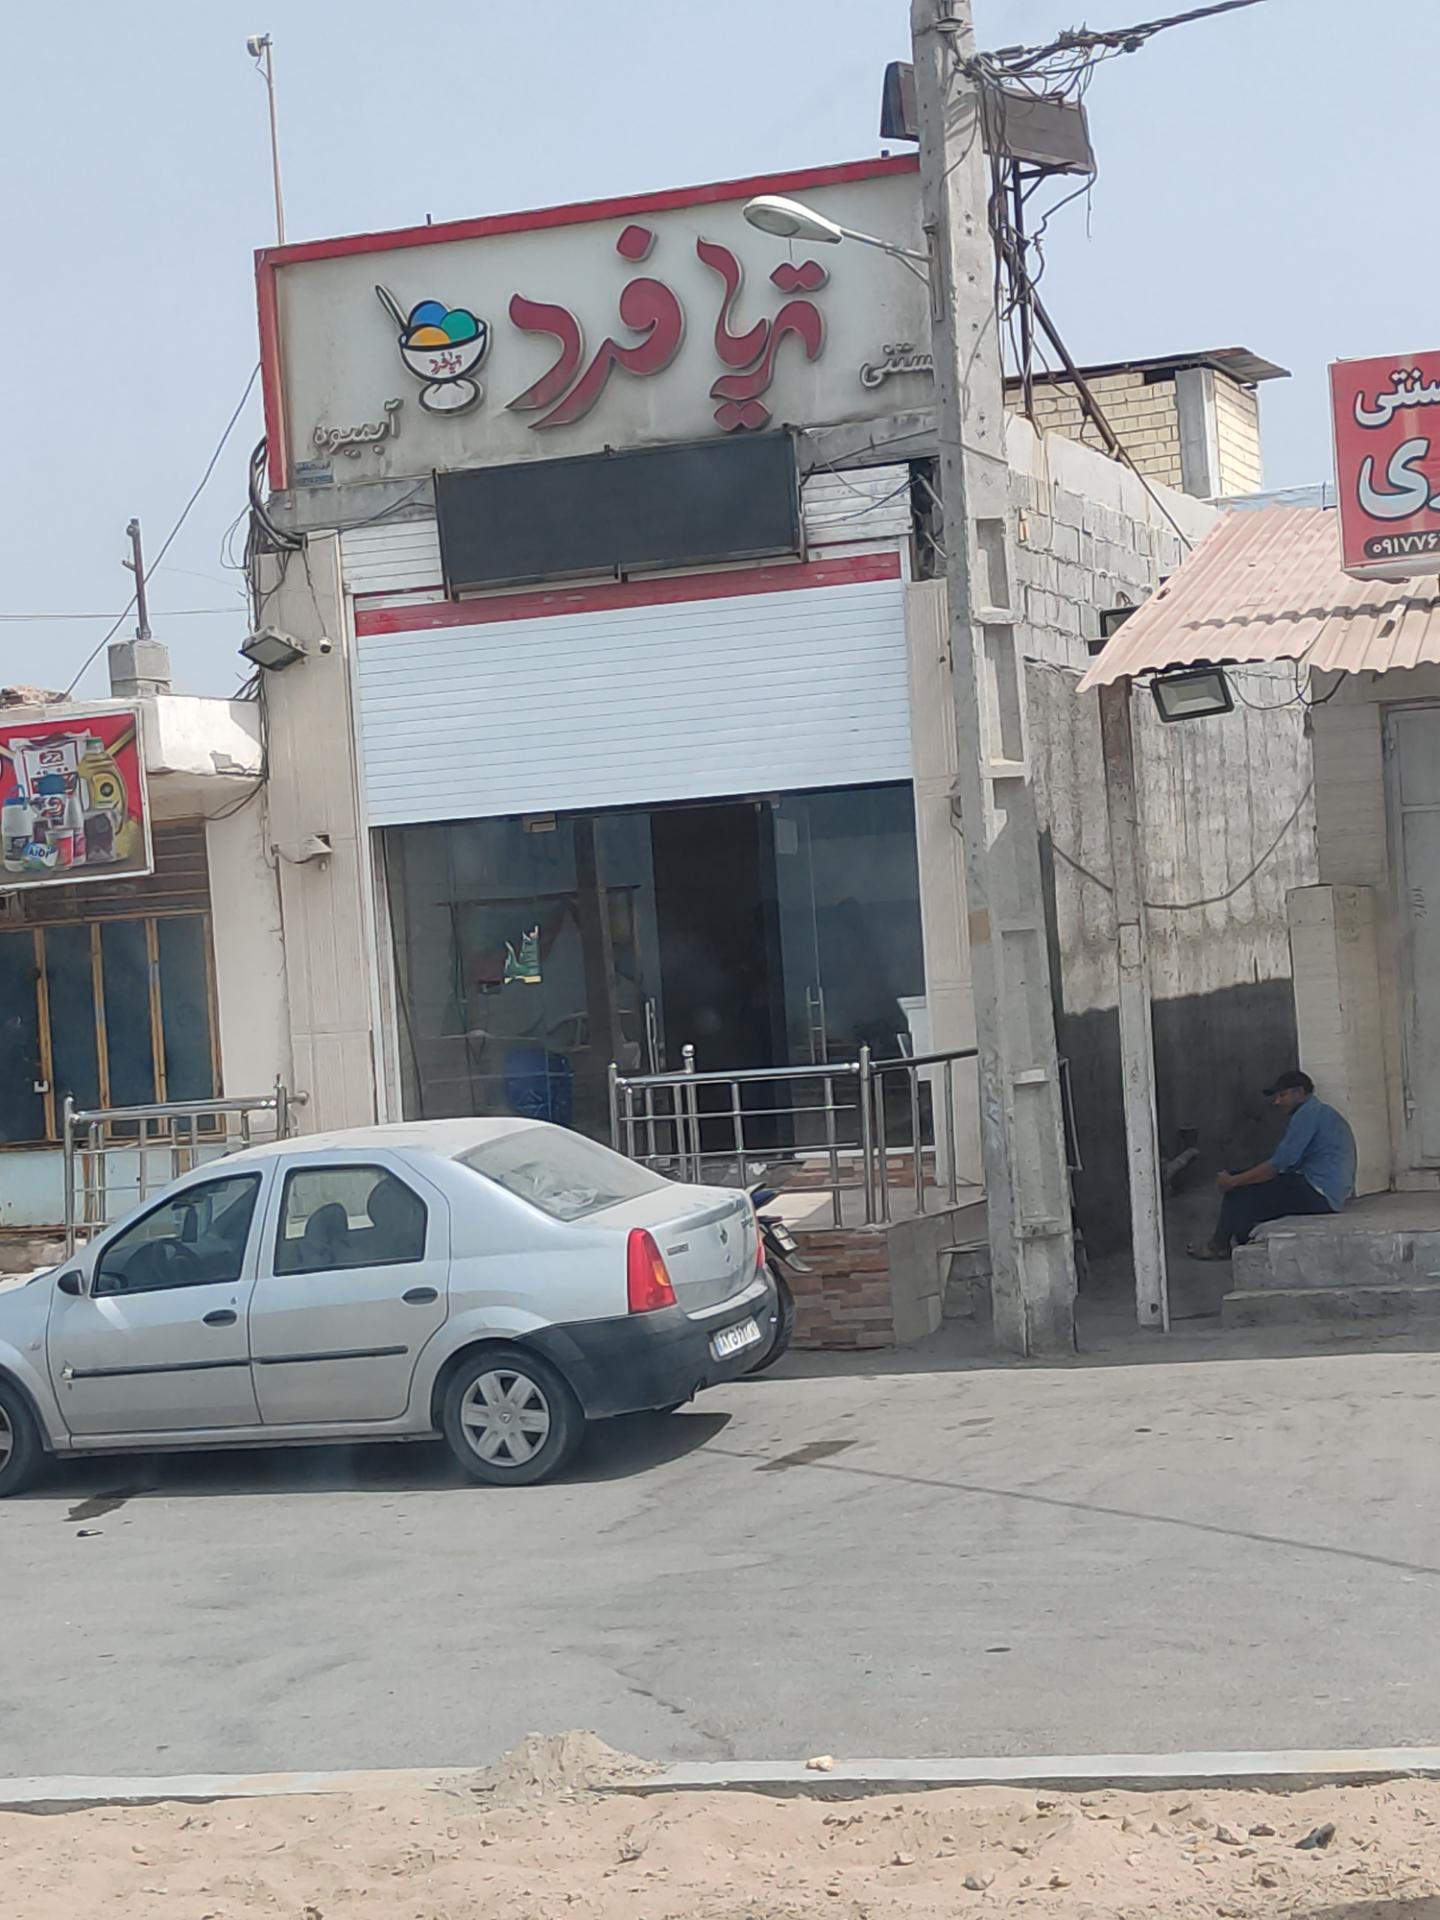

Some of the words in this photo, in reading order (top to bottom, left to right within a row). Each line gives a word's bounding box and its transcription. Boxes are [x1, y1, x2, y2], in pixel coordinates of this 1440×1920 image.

[505, 225, 829, 431] تیافرد
[860, 342, 935, 388] ستنی
[313, 398, 403, 457] آبمیوه
[1372, 533, 1440, 554] ۰۹۱۷۷۶
